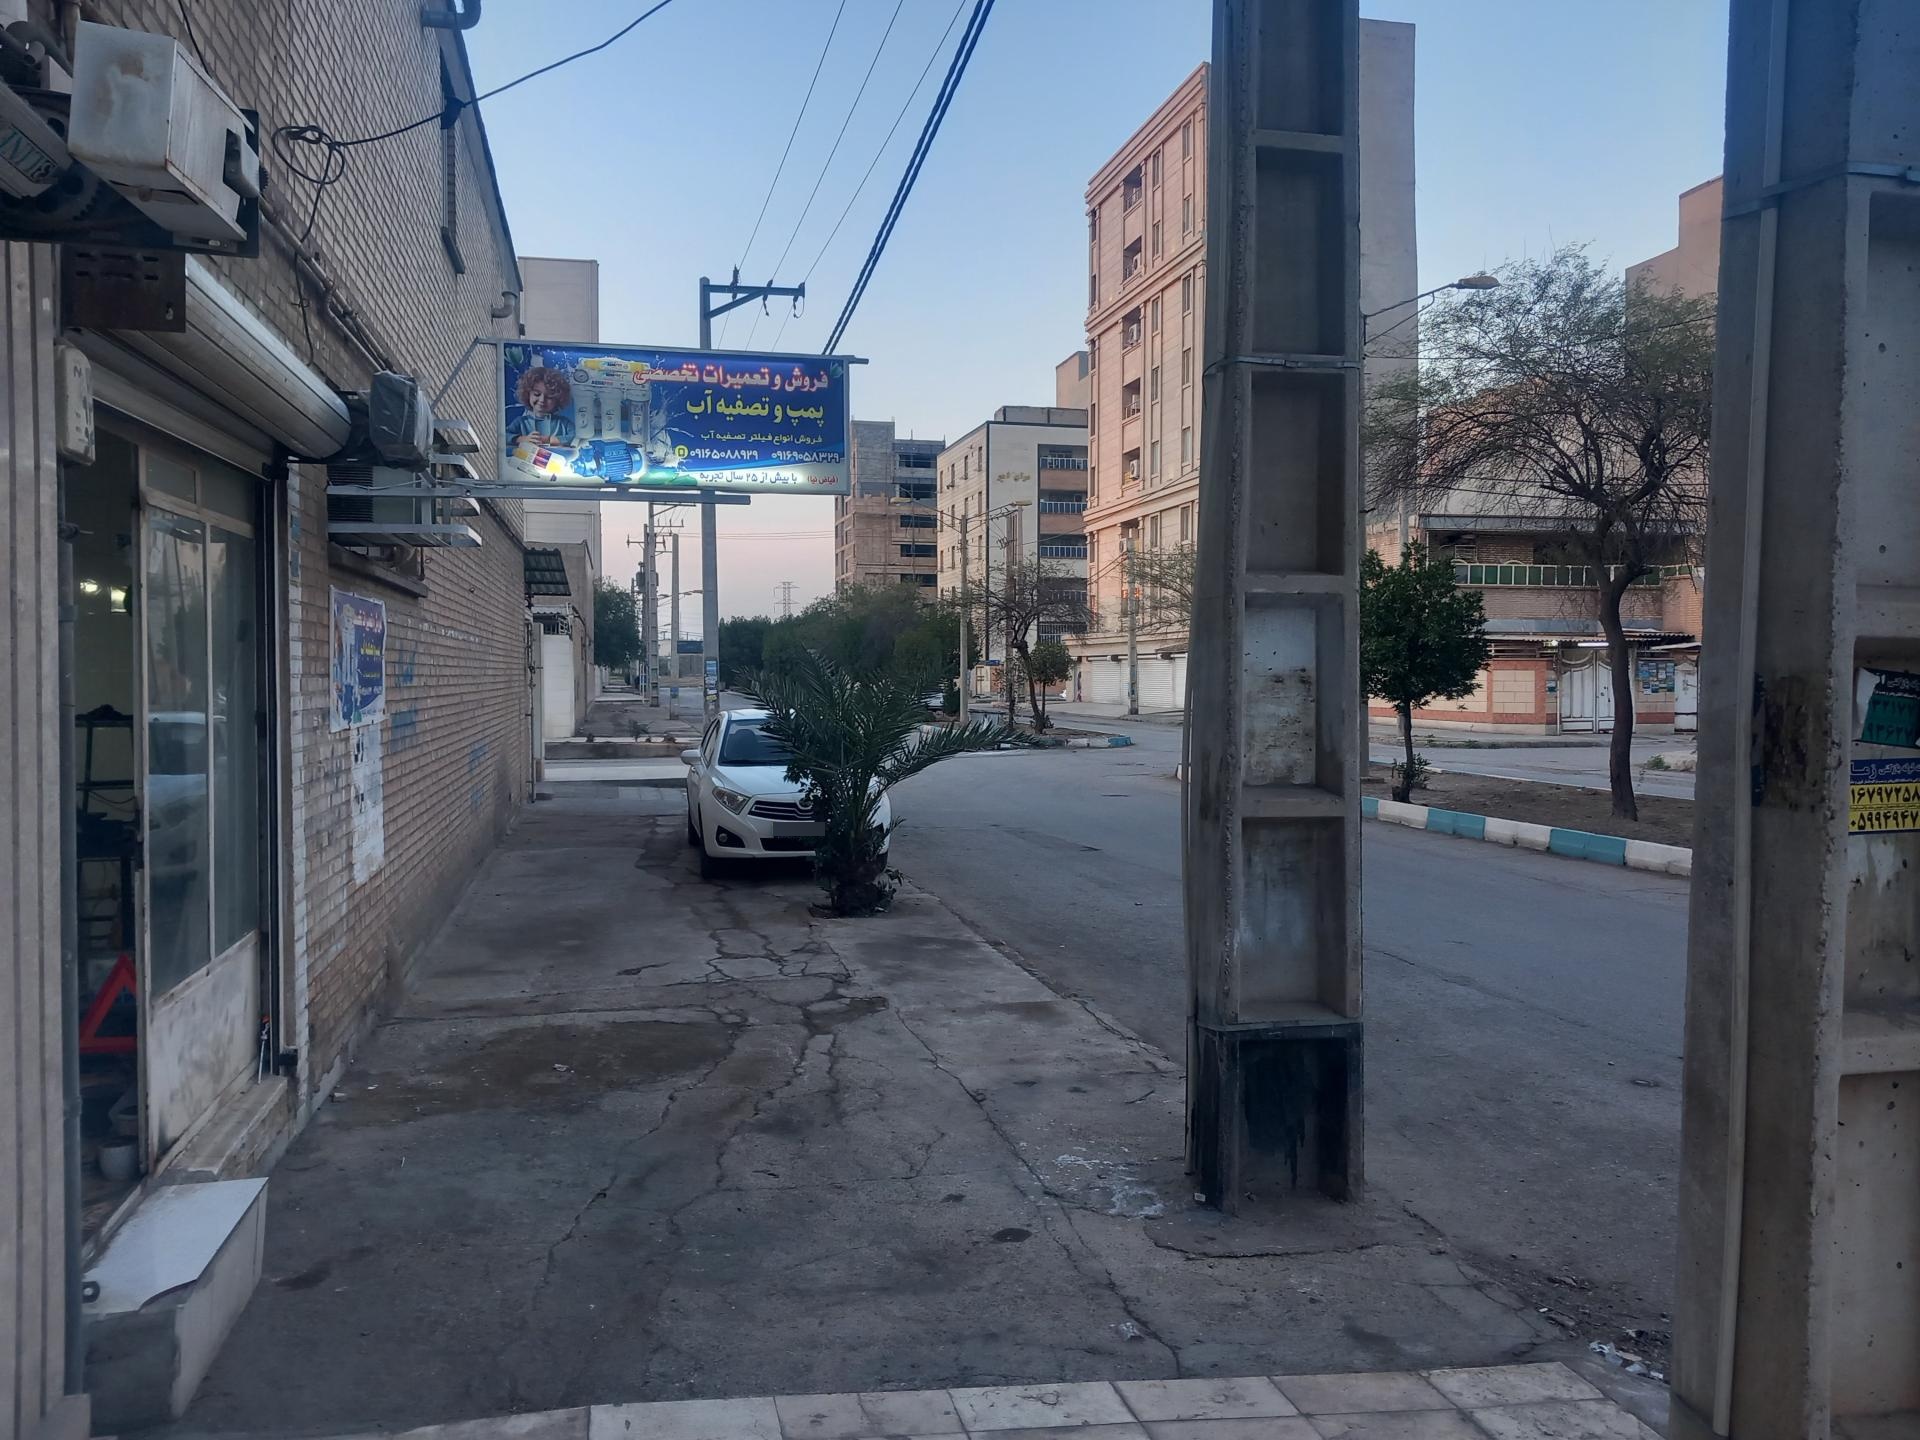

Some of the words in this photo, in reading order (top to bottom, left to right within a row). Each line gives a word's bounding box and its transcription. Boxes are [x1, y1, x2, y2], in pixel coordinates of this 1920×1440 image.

[633, 361, 699, 385] تخصصی
[702, 364, 770, 390] تعمیرات
[784, 365, 829, 392] فروش
[771, 375, 782, 391] و
[686, 389, 713, 420] آب
[716, 394, 769, 421] تصفیه
[773, 406, 783, 423] و
[786, 404, 824, 427] پمپ
[701, 430, 715, 441] آب
[716, 432, 746, 441] تصفیه
[748, 432, 772, 443] فیلتر
[773, 434, 793, 446] انواع
[794, 435, 823, 445] فروش
[690, 448, 758, 460] ۰۹۱۶۵۰۸۸۹۲۹
[771, 450, 839, 463] ۰۹۱۶۹۰۵۸۳۲۹
[699, 471, 724, 483] تجربه
[725, 471, 744, 483] سال
[746, 473, 758, 482] ۲۵
[760, 472, 768, 483] از
[769, 471, 790, 484] بیش
[791, 472, 798, 484] با
